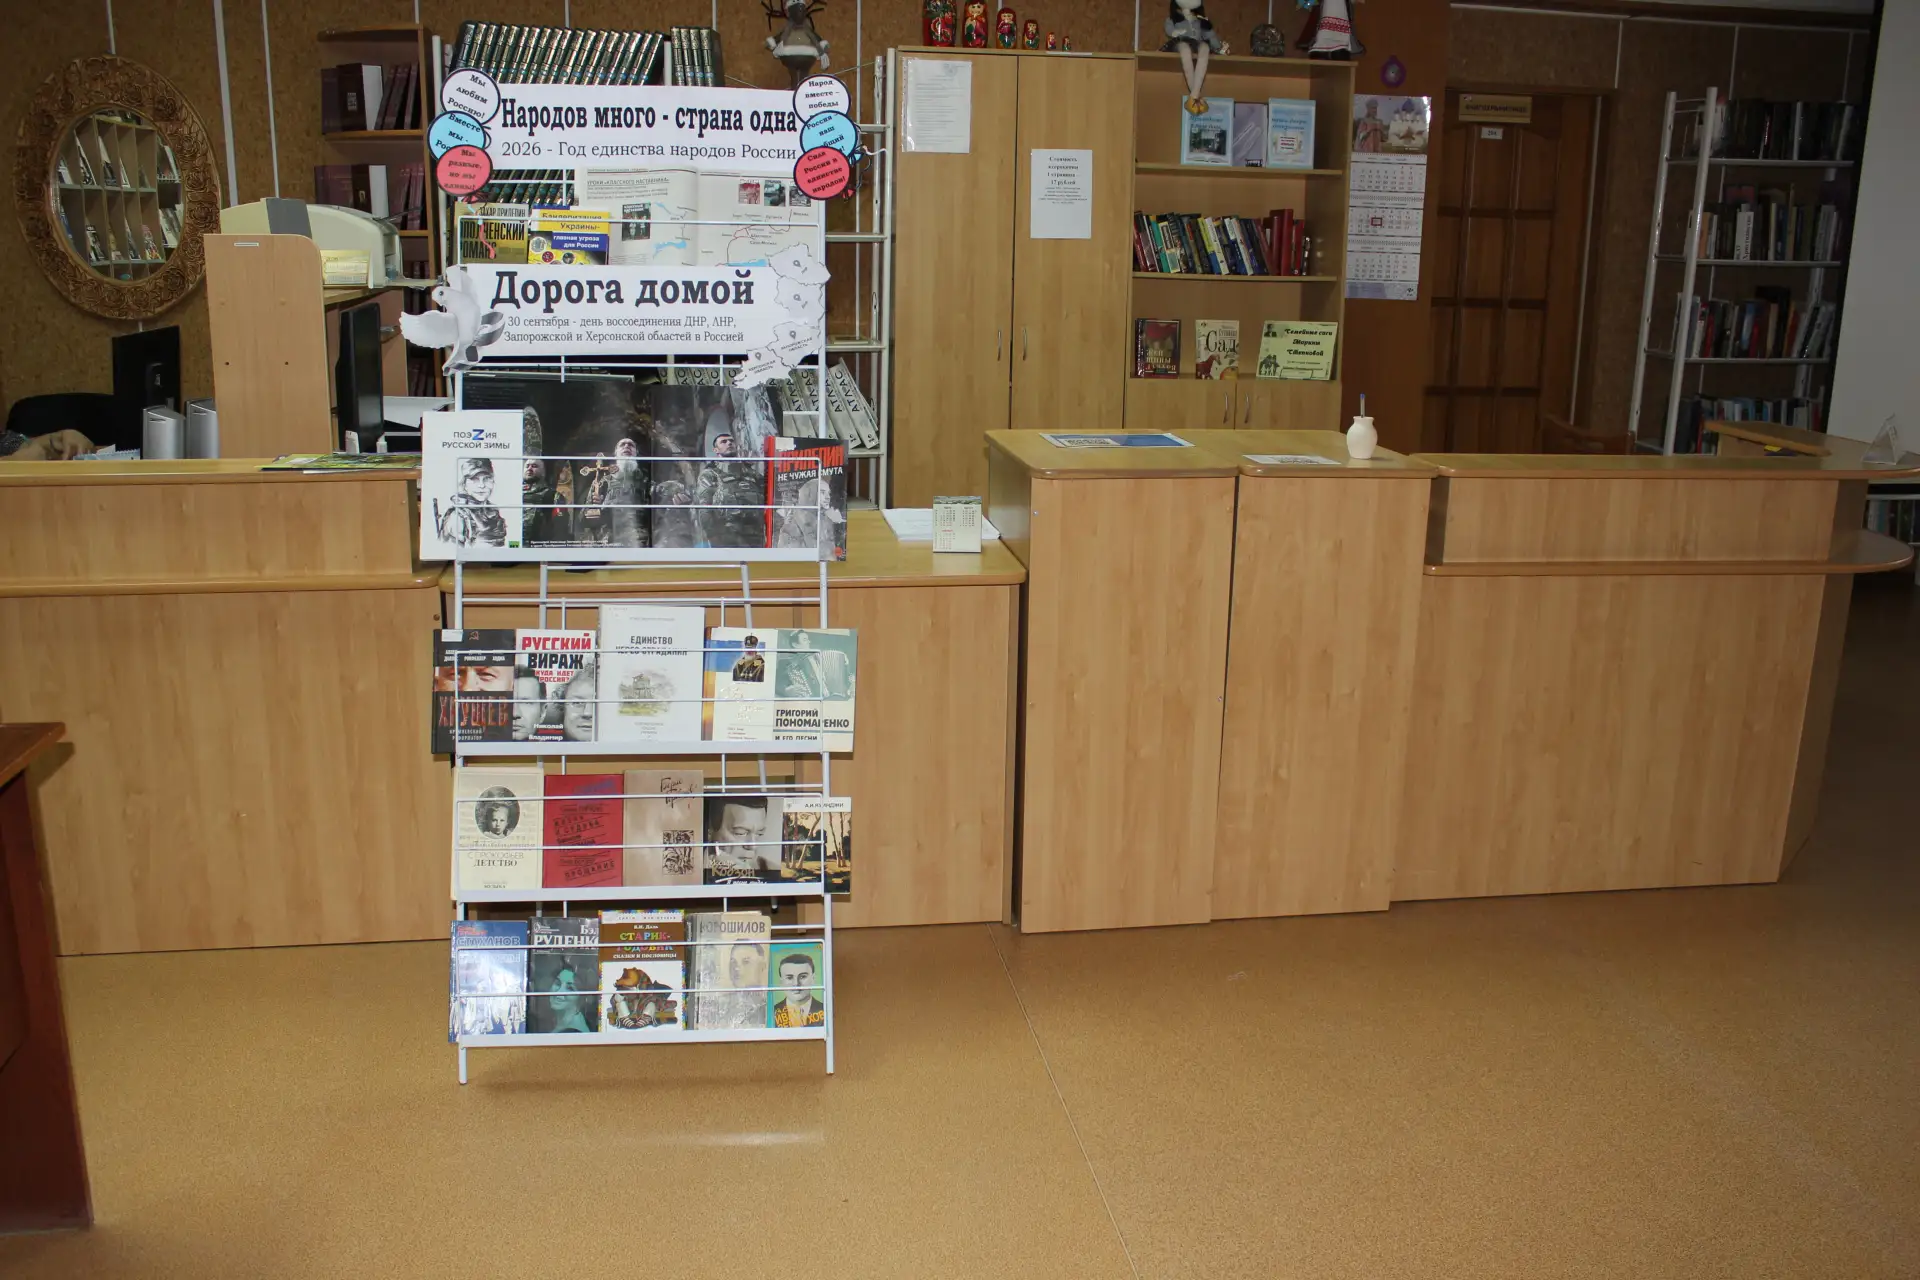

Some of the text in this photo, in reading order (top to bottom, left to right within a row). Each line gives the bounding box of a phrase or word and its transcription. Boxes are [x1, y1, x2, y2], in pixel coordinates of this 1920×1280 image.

[470, 74, 486, 88] Мы
[808, 80, 834, 88] Народ
[456, 86, 488, 104] любим
[805, 90, 834, 99] вместе
[447, 97, 485, 119] Россию!
[808, 100, 839, 109] победы
[448, 113, 481, 133] Вместе
[501, 98, 588, 137] Народов
[594, 105, 656, 130] много
[675, 106, 744, 138] страна
[749, 109, 798, 135] одна
[806, 115, 833, 131] Россия
[448, 130, 464, 142] мы
[818, 125, 835, 137] наш
[821, 134, 845, 148] бщий
[461, 149, 476, 157] Мы
[501, 141, 541, 156] 2026
[558, 142, 587, 158] Год
[591, 143, 664, 159] единства
[669, 144, 736, 161] народов
[740, 144, 797, 159] России
[807, 150, 826, 161] Сила
[804, 160, 832, 174] России
[812, 176, 846, 194] народов!
[498, 207, 526, 218] ПРИЛЕПИН
[461, 218, 525, 241] ПОЛЧЕНСКИЙ
[560, 222, 601, 231] Украины-
[553, 234, 600, 244] главная угроза
[563, 242, 576, 250] для
[490, 269, 754, 314] Дорога домой
[507, 316, 521, 327] 30
[523, 316, 570, 330] сентября
[580, 318, 603, 328] день
[606, 318, 681, 328] воссоединения
[684, 316, 710, 329] ДНР,
[712, 316, 737, 329] ЛНР,
[504, 330, 744, 345] Запорожской и Херсонской областей в Россией
[1206, 329, 1237, 355] Сад
[1292, 338, 1321, 346] Марины
[1286, 348, 1324, 357] Степновой
[834, 369, 860, 412] АТЛАС
[442, 441, 482, 449] РУССКОЙ
[778, 473, 788, 481] НЕ
[789, 469, 816, 480] ЧУЖАЯ
[521, 633, 591, 650] РУССКИЙ
[630, 635, 673, 645] ЕДИНСТВО
[528, 653, 583, 669] ВИРАЖ
[776, 708, 818, 718] ГРИГОРИЙ
[473, 859, 517, 868] ДЕТСТВО
[580, 924, 598, 935] Бэл
[620, 932, 671, 941] СТАРИК-
